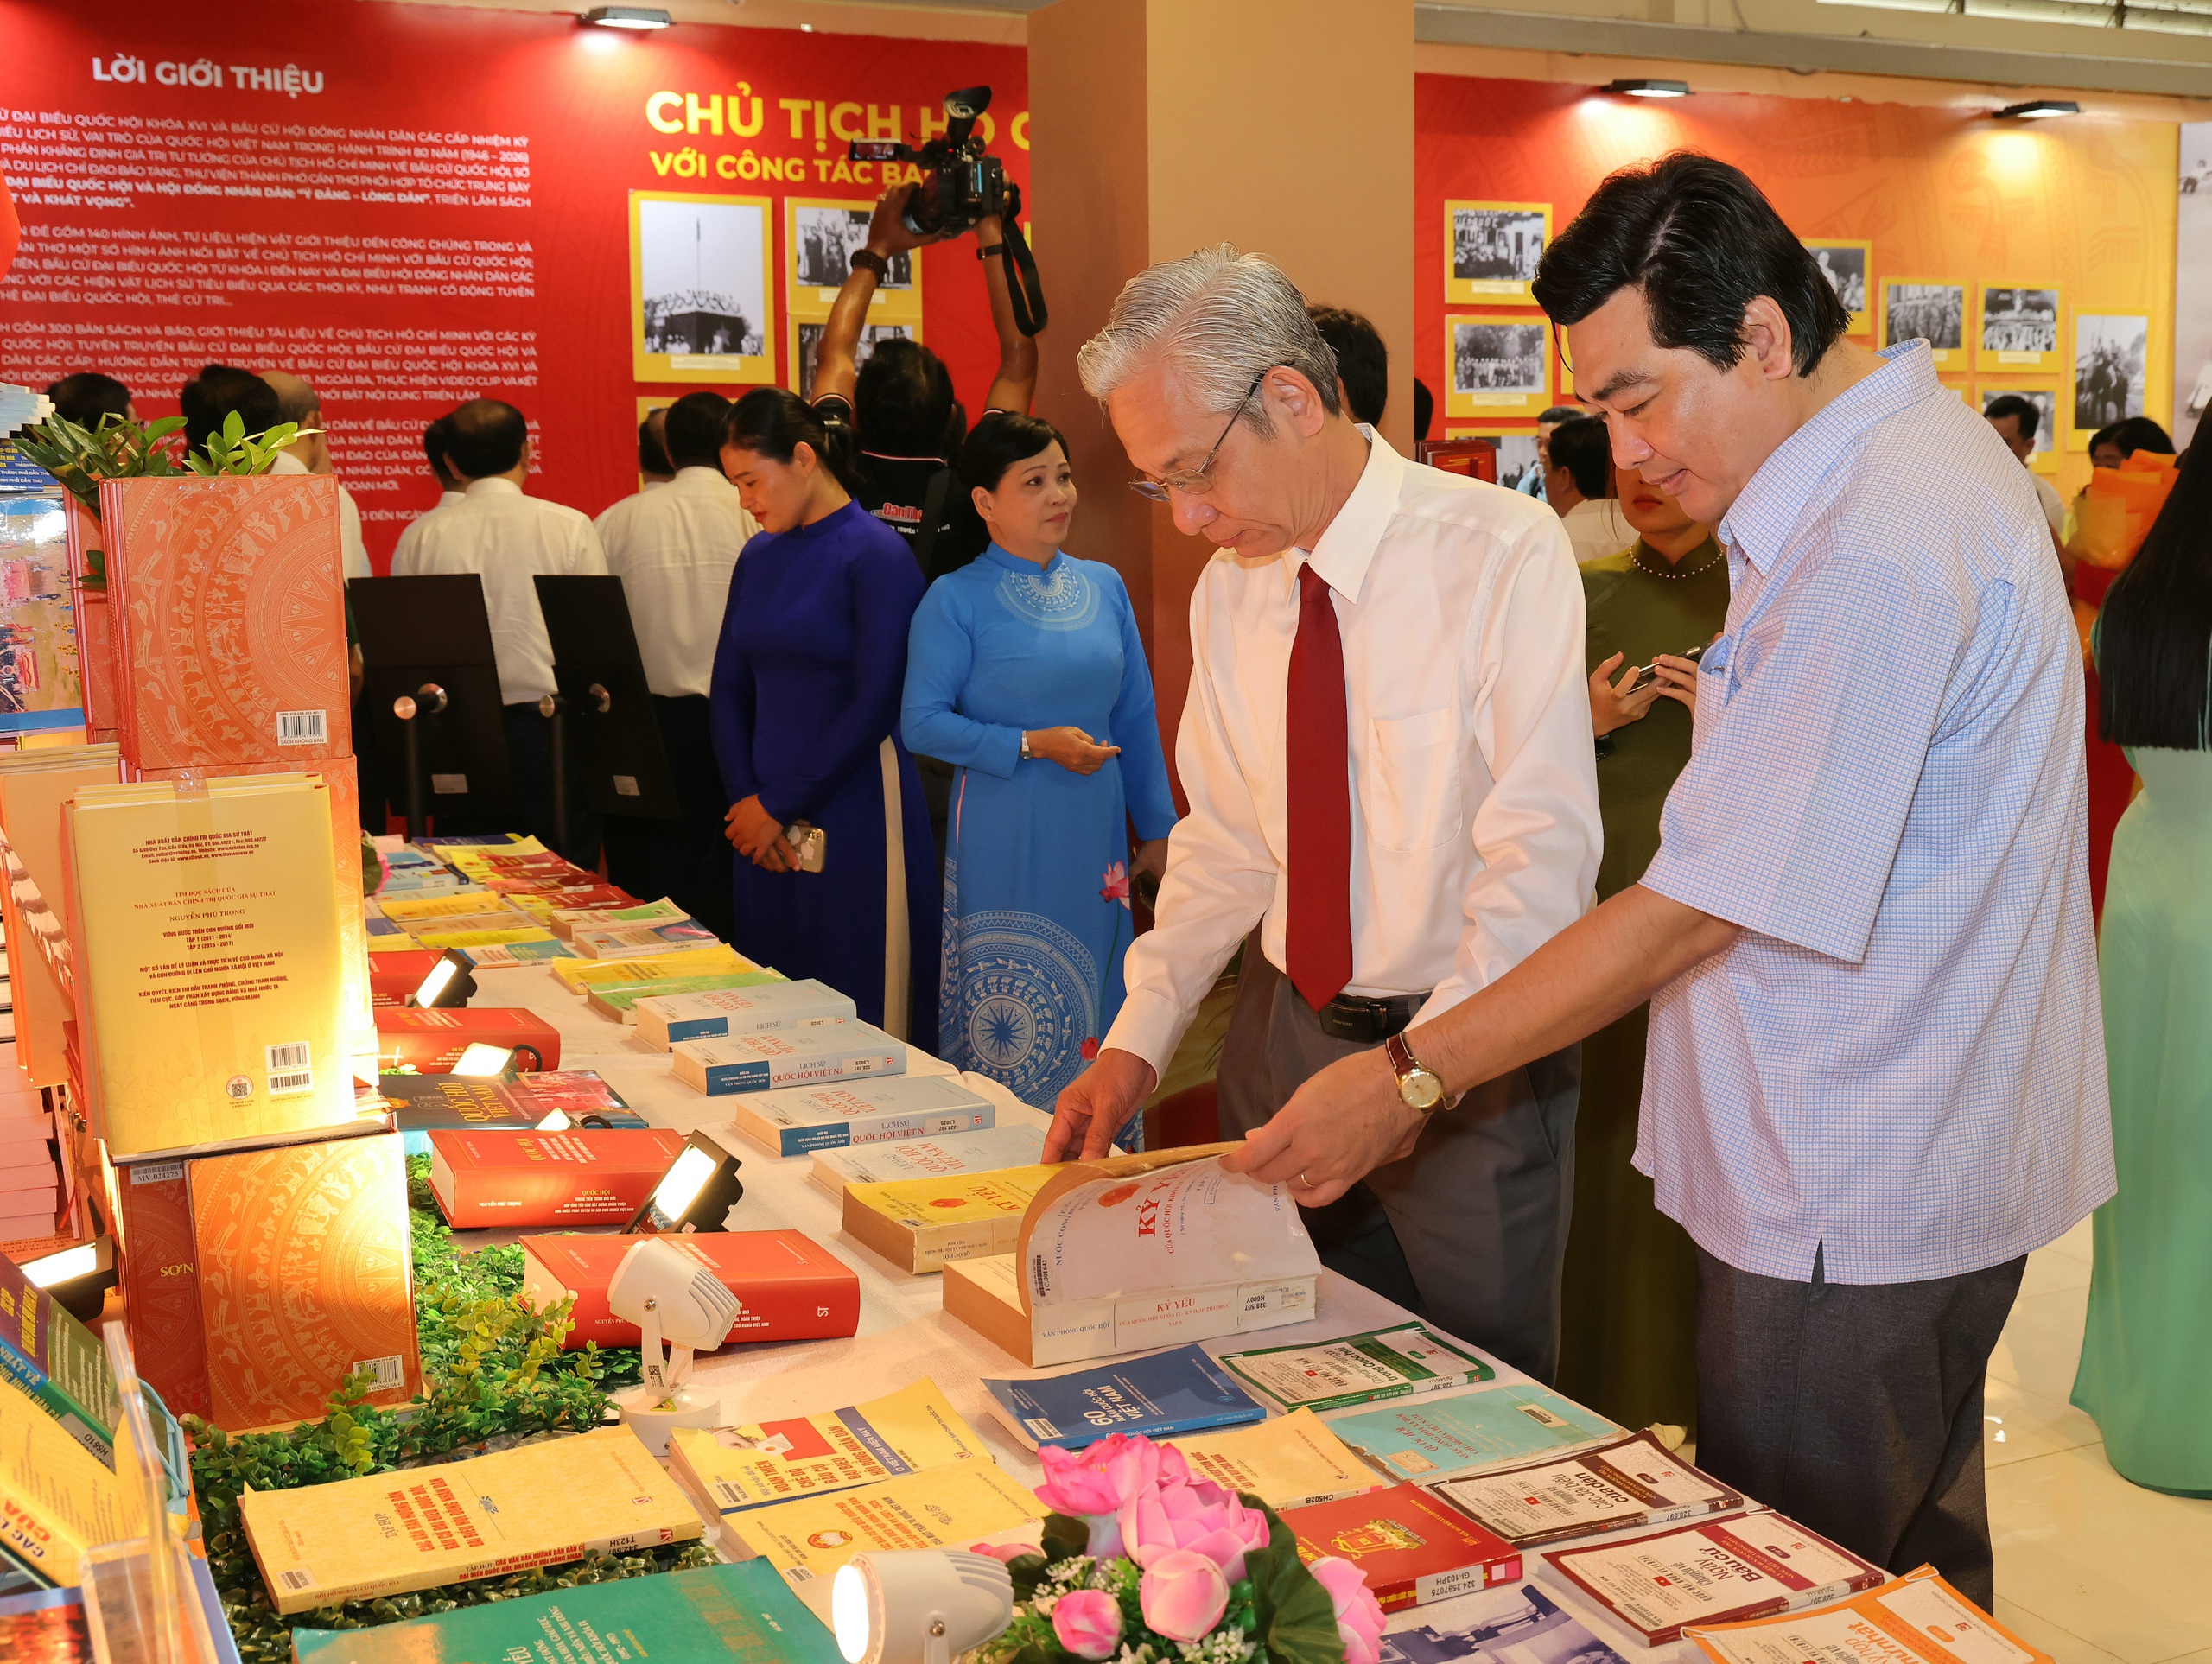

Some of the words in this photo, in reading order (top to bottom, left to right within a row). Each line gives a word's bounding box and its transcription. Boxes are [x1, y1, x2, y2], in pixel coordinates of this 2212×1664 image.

[92, 52, 146, 83] LỜI
[154, 58, 222, 87] GIỚI
[231, 63, 323, 98] THIỆU
[645, 82, 764, 138] CHỦ
[779, 99, 901, 151] TỊCH
[10, 110, 36, 124] ĐẠI
[39, 110, 72, 124] BIỂU
[73, 112, 115, 127] QUỐC
[118, 115, 143, 130] HỘI
[145, 117, 183, 130] KHÓA
[187, 120, 207, 130] XVI
[210, 121, 227, 131] VÀ
[231, 121, 257, 134] BẦU
[260, 124, 279, 135] CỬ
[282, 124, 306, 137] HỘI
[308, 124, 346, 138] ĐỒNG
[349, 127, 385, 140] NHÂN
[388, 128, 416, 142] DÂN
[416, 130, 442, 143] CÁC
[443, 130, 469, 144] CẤP
[471, 133, 511, 147] NHIỆM
[512, 134, 529, 147] KỲ
[648, 147, 707, 180] VỚI
[715, 150, 805, 181] CÔNG
[813, 154, 873, 184] TÁC
[169, 911, 200, 922] NGUYỄN
[201, 910, 217, 918] PHÚ
[219, 908, 245, 917] TRỌNG
[756, 1020, 772, 1030] LỊCH
[772, 1019, 782, 1028] SỬ
[799, 1061, 813, 1070] LỊCH
[772, 1072, 796, 1083] QUỐC
[798, 1070, 813, 1079] HỘI
[814, 1069, 832, 1078] VIỆT
[435, 1082, 464, 1100] HỘI
[471, 1083, 498, 1102] NAM
[443, 1096, 489, 1122] QUỐC
[483, 1100, 512, 1120] VIỆT
[881, 1121, 899, 1130] LỊCH
[899, 1119, 910, 1128] SỬ
[853, 1133, 878, 1143] QUỐC
[879, 1131, 895, 1140] HỘI
[897, 1129, 916, 1139] VIỆT
[137, 1171, 179, 1182] MV.024275
[1136, 1197, 1160, 1238] KỶ
[160, 1262, 194, 1277] SƠN
[1157, 1299, 1172, 1312] KỶ
[1173, 1296, 1196, 1311] YẾU
[1057, 1326, 1078, 1337] PHÒNG
[1079, 1324, 1097, 1334] QUỐC
[1098, 1321, 1109, 1331] HỘI
[1082, 1388, 1098, 1398] HỘI
[1096, 1384, 1126, 1403] NAM
[1090, 1396, 1113, 1410] QUỐC
[1083, 1410, 1114, 1426] 60
[1106, 1409, 1127, 1422] NĂM
[1116, 1402, 1144, 1420] VIỆT
[827, 1425, 846, 1439] DÂN
[856, 1426, 870, 1439] NAY
[84, 1432, 109, 1457] H561D
[838, 1437, 862, 1453] NHÂN
[866, 1436, 880, 1449] HIỆN
[876, 1447, 893, 1458] NAM
[754, 1460, 778, 1478] THIỆN
[827, 1457, 853, 1470] BIỂU
[885, 1456, 901, 1468] VIỆT
[864, 1466, 886, 1477] HỘI
[429, 1477, 448, 1489] DÂN
[766, 1477, 792, 1493] HOÀN
[788, 1477, 816, 1489] CHẾ
[814, 1473, 840, 1485] BẦU
[1551, 1473, 1579, 1489] biểu
[1574, 1472, 1605, 1489] dân
[385, 1490, 406, 1502] DẪN
[435, 1488, 456, 1502] NHÂN
[1573, 1484, 1595, 1498] đại
[1601, 1487, 1630, 1503] của
[412, 1495, 436, 1509] QUỐC
[1306, 1494, 1334, 1504] CH502B
[1588, 1496, 1614, 1510] Các
[393, 1502, 416, 1520] HƯỚNG
[421, 1508, 442, 1521] BIỂU
[3, 1499, 52, 1543] CỦA
[374, 1513, 391, 1527] HỢP
[402, 1518, 423, 1530] BẢN
[452, 1515, 471, 1527] HỘI
[380, 1526, 398, 1539] TẬP
[409, 1529, 429, 1541] VĂN
[455, 1525, 479, 1539] BIỂU
[11, 1527, 45, 1559] CÁC
[415, 1540, 435, 1552] CÁC
[438, 1538, 461, 1550] BẦU
[609, 1536, 636, 1547] T123H
[1698, 1547, 1731, 1562] cử
[1694, 1559, 1735, 1580] Ngày
[1725, 1559, 1764, 1583] Bầu
[1436, 1571, 1470, 1585] GI-103PH
[1431, 1579, 1476, 1597] 324.2597075
